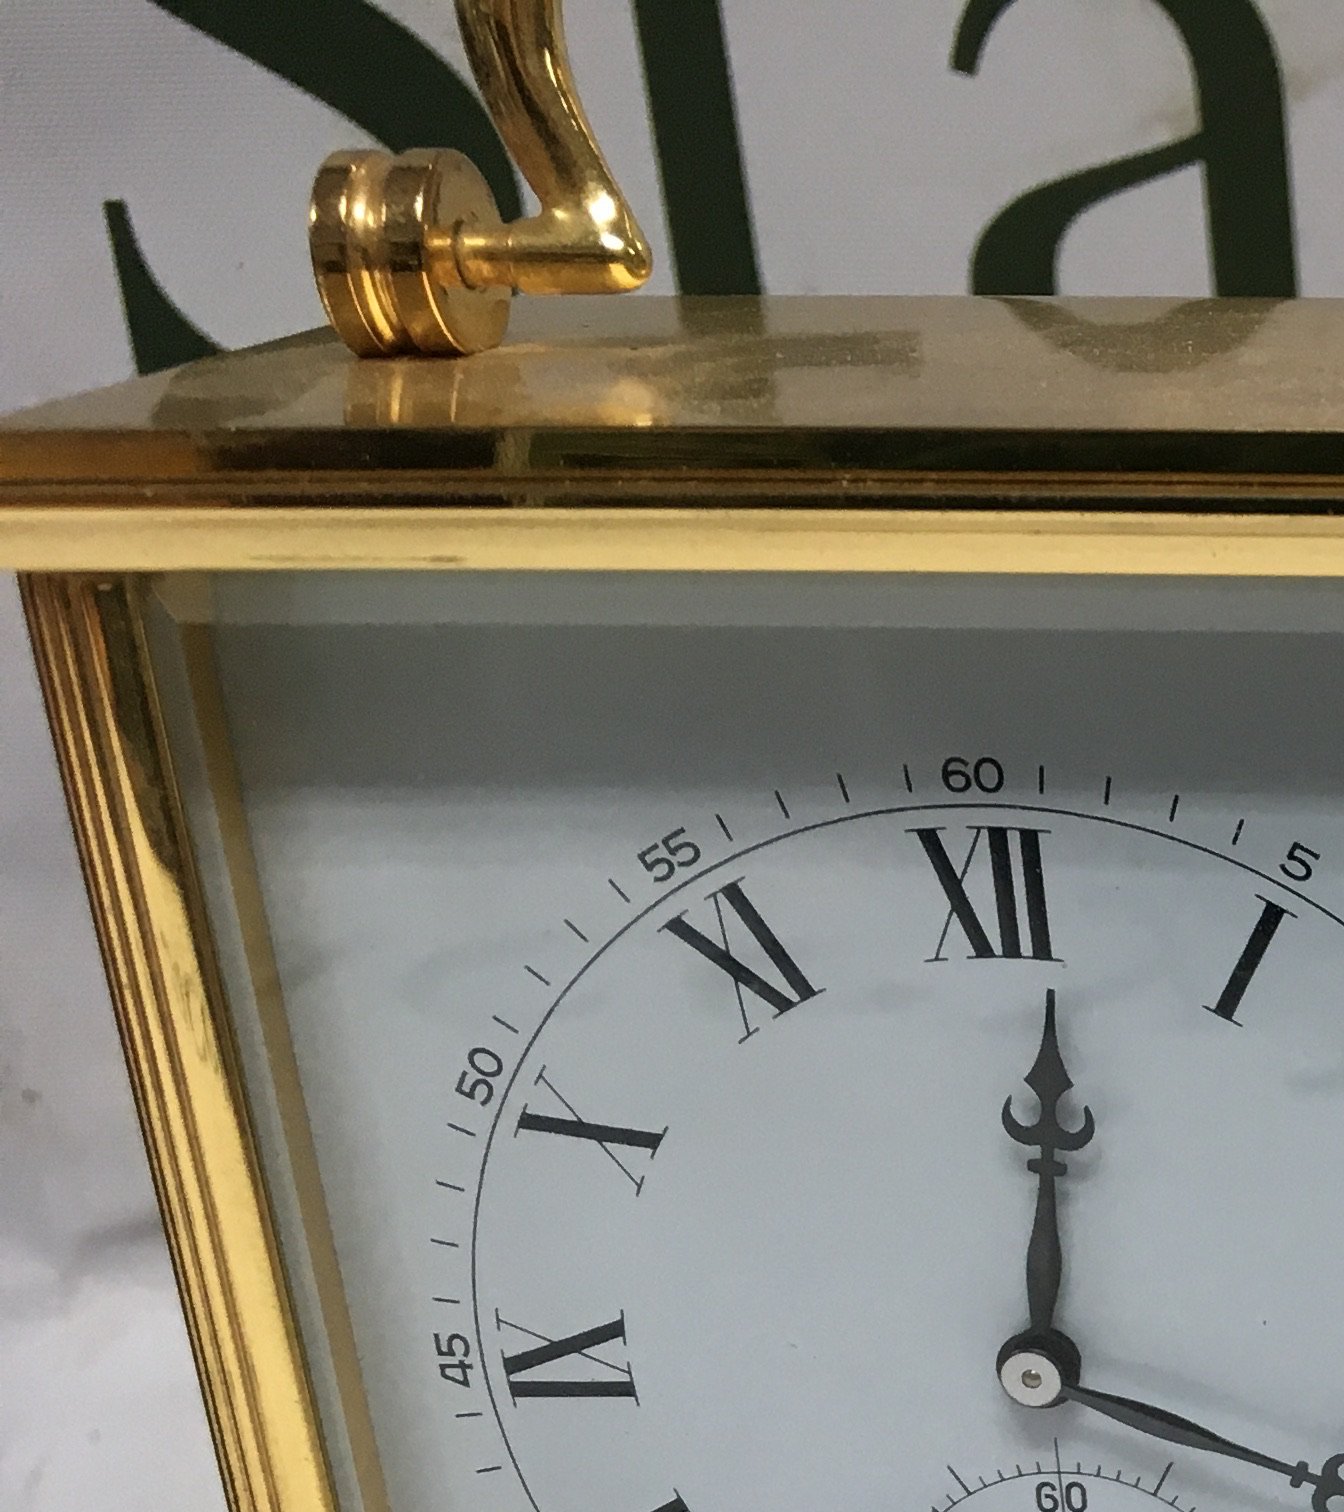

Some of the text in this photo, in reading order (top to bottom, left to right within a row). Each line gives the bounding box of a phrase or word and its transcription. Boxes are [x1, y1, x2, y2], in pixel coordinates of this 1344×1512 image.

[941, 756, 1004, 792] 60
[637, 827, 700, 882] 55
[1279, 842, 1321, 882] 5
[904, 826, 1064, 963] XII
[657, 876, 826, 1044] XI
[1202, 894, 1298, 1027] I
[455, 1047, 503, 1105] 50
[514, 1064, 669, 1196] X
[434, 1332, 471, 1388] 45
[496, 1308, 640, 1407] IX
